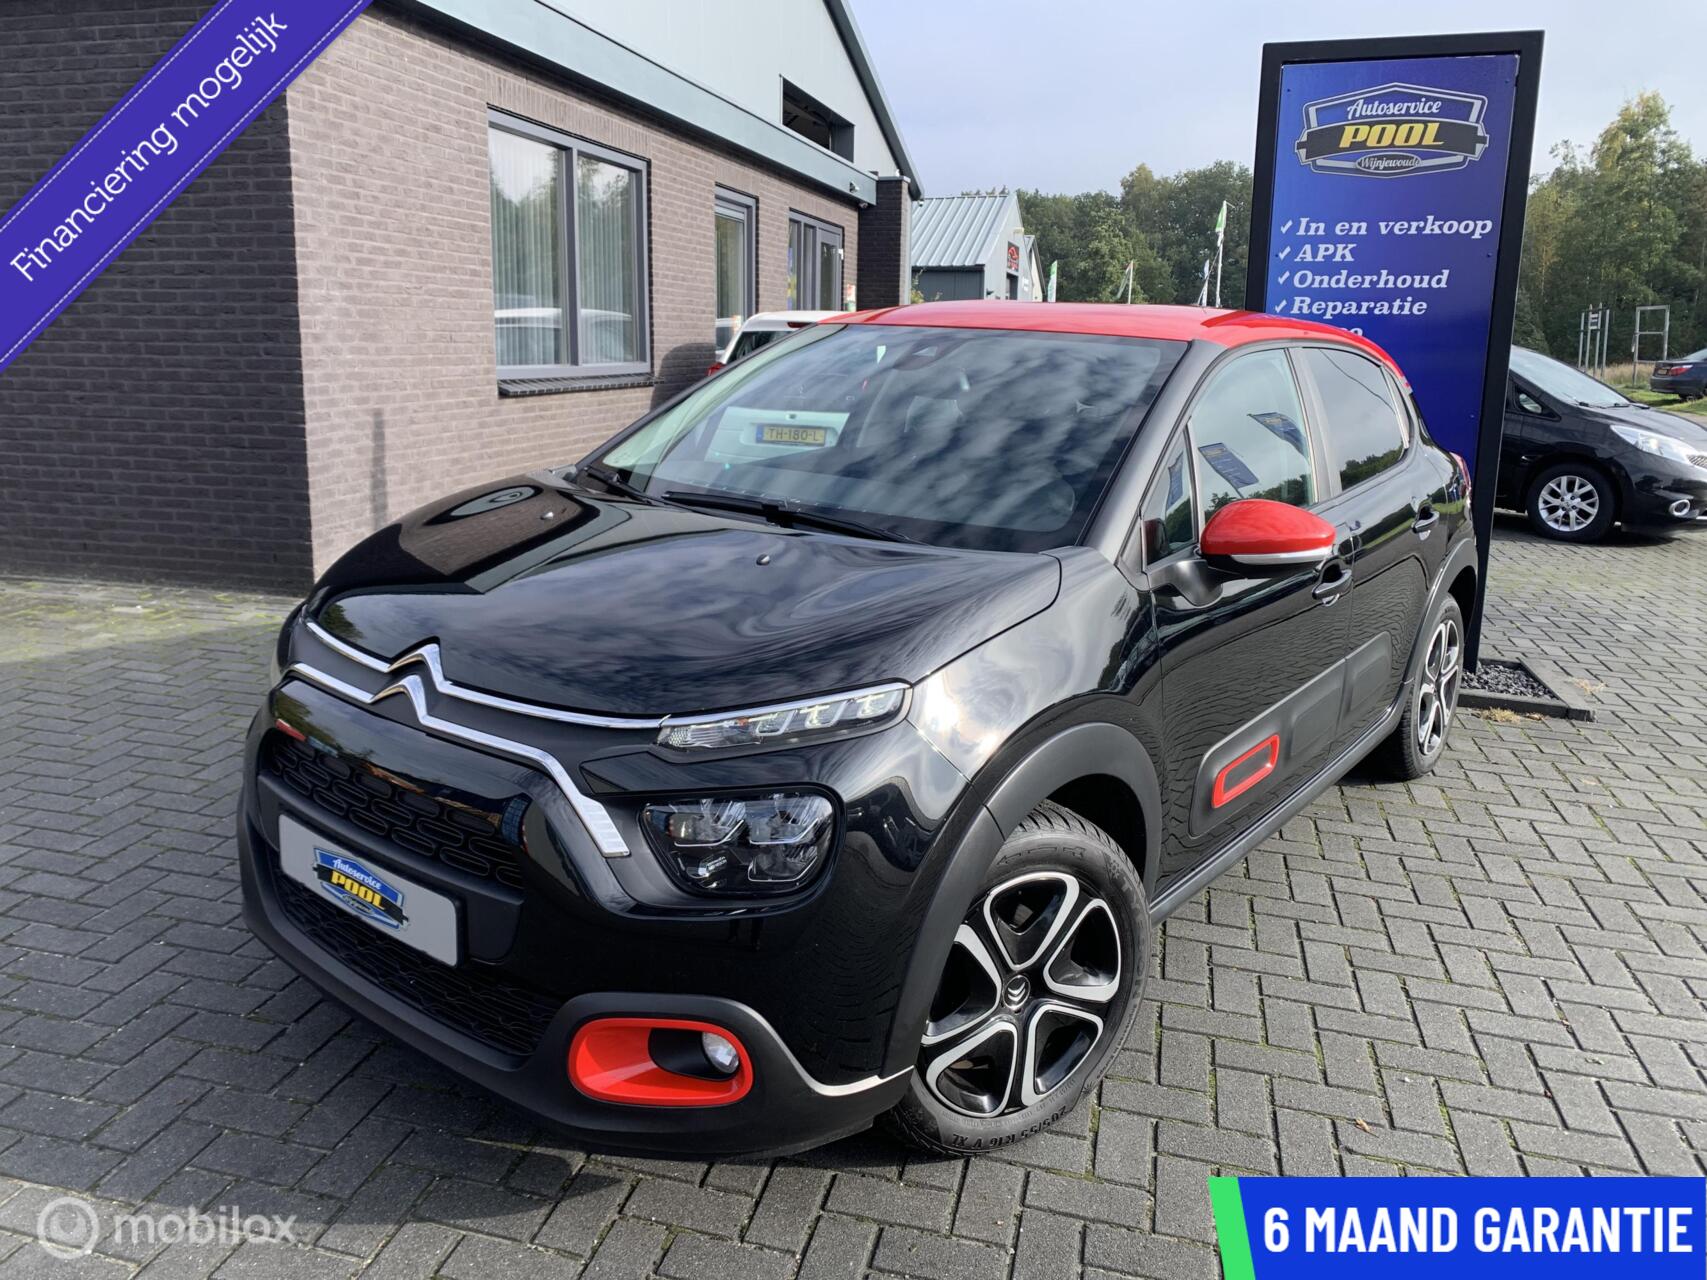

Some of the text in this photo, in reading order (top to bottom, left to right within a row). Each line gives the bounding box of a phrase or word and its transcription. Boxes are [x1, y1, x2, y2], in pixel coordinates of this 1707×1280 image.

[1347, 98, 1442, 120] Autoservice
[1339, 122, 1445, 148] POOL
[1296, 215, 1493, 239] In en verkoop
[1294, 243, 1357, 262] APK
[1293, 269, 1450, 289] Onderhoud
[1290, 296, 1428, 320] Reparatie
[768, 428, 820, 441] TH-180-L
[332, 858, 382, 890] Autoservice
[331, 870, 385, 910] POOL
